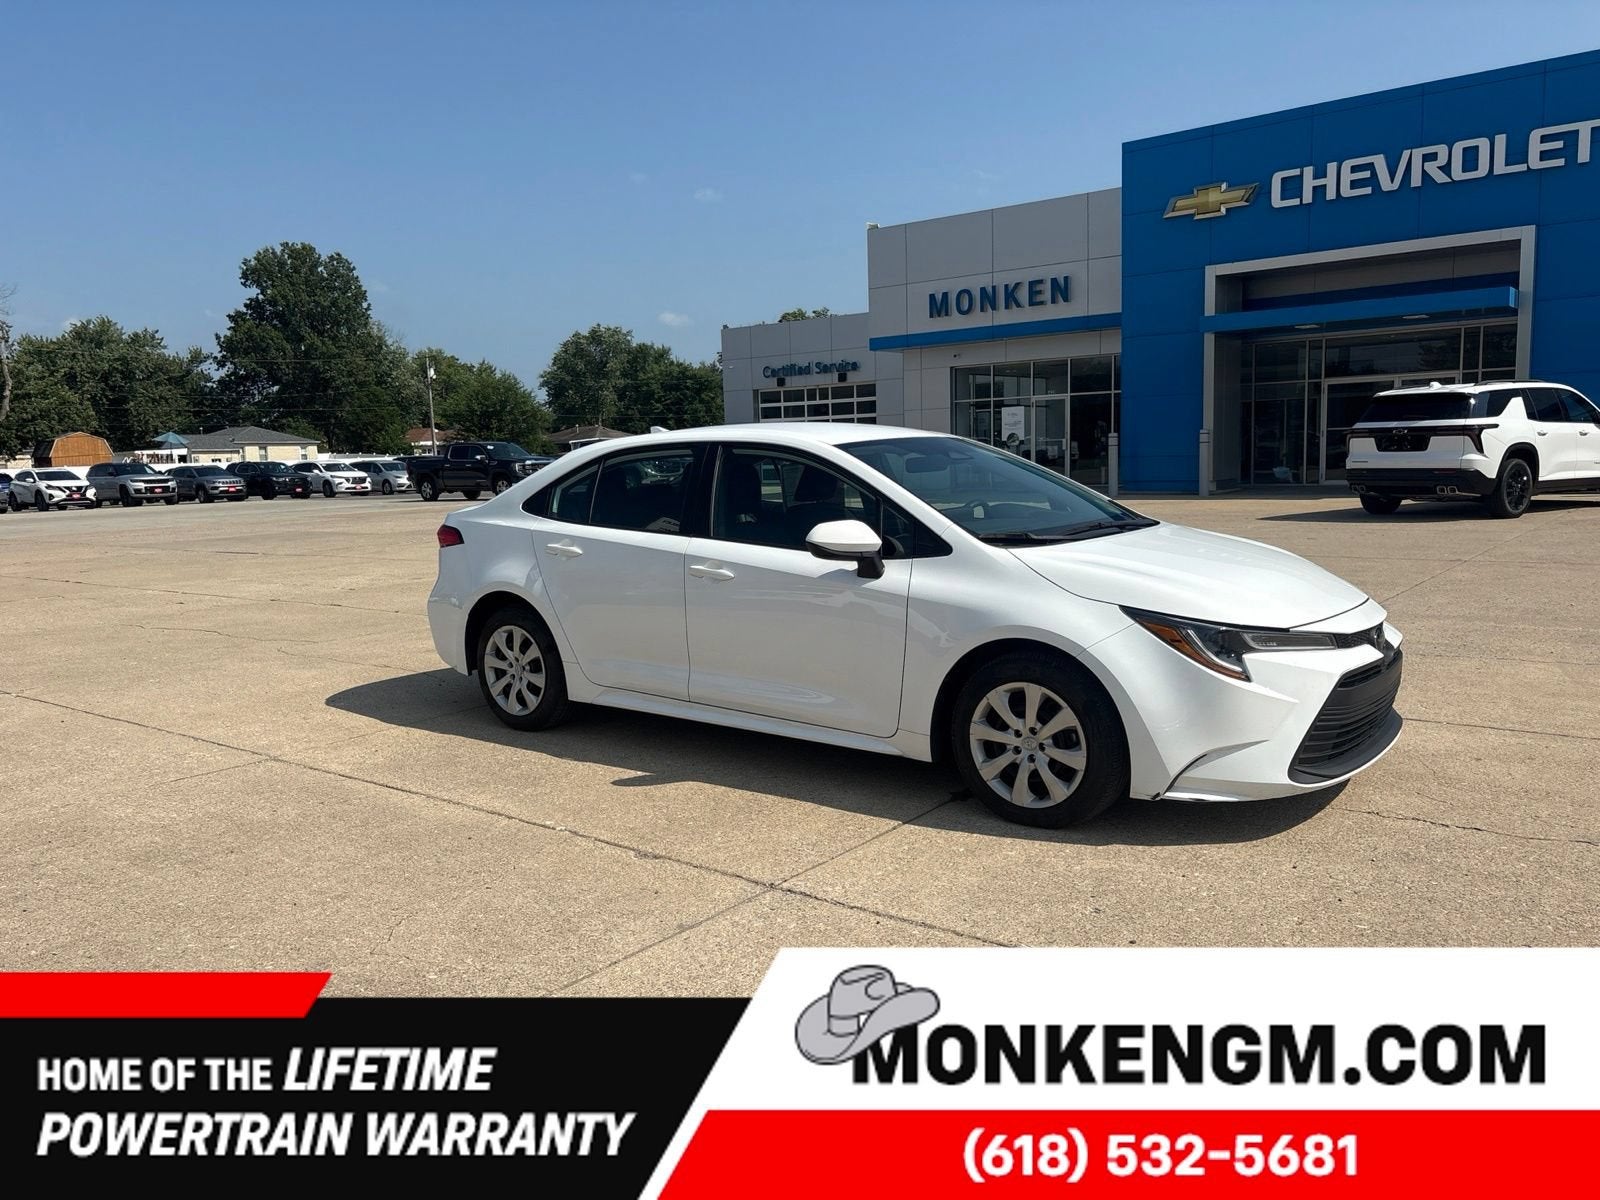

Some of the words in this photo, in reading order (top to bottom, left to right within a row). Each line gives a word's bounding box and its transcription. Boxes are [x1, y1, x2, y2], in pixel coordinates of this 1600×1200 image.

[1270, 118, 1600, 209] CHEVROLET
[928, 275, 1071, 318] MONKEN
[763, 361, 812, 378] Certified
[814, 360, 858, 375] Service
